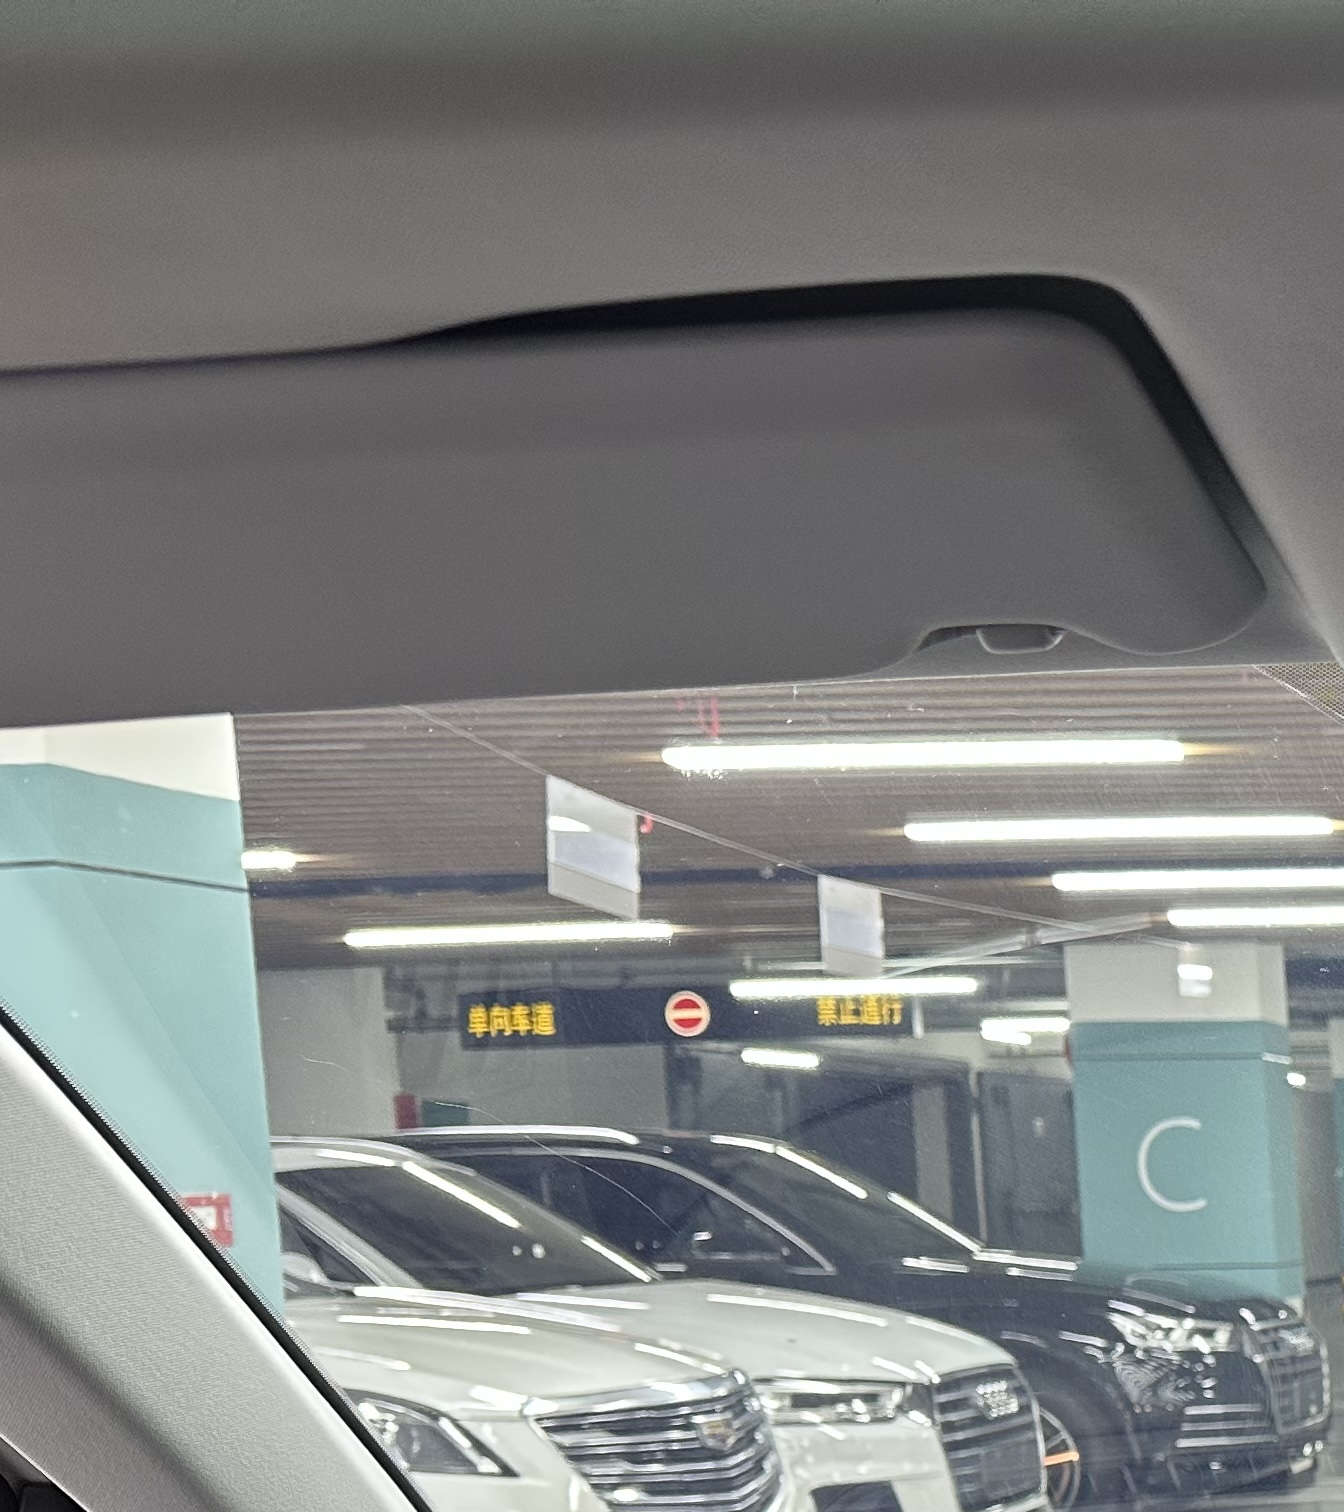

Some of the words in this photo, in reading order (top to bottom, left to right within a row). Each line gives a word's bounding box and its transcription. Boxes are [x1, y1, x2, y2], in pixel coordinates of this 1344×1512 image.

[468, 1002, 556, 1038] 单向车道
[816, 994, 903, 1026] 禁止通行
[1138, 1116, 1208, 1213] C
